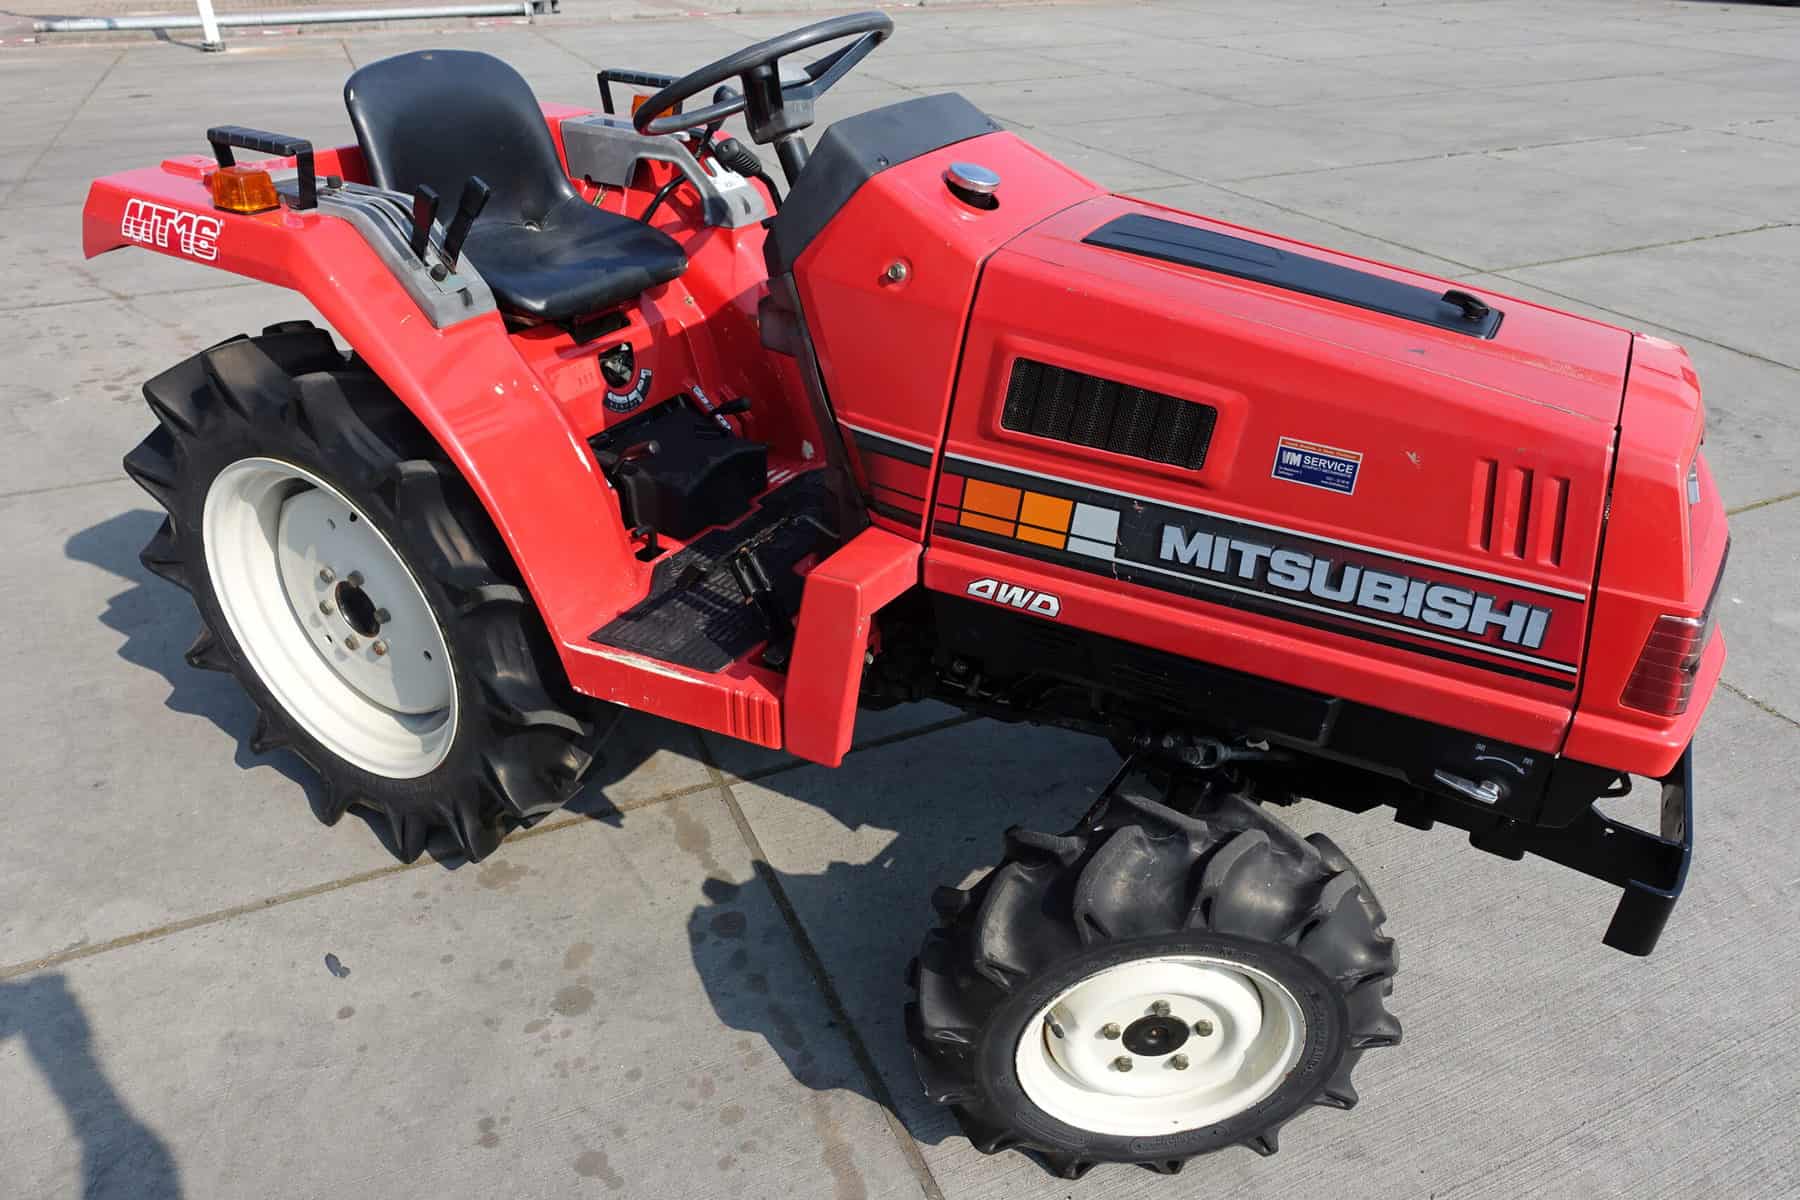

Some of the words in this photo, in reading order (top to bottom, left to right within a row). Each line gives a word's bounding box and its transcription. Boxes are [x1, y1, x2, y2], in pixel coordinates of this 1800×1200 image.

[122, 198, 220, 261] MT16
[1303, 455, 1354, 475] SERVICE
[967, 578, 1060, 618] 4WD
[1159, 523, 1552, 650] MITSUBISHI
